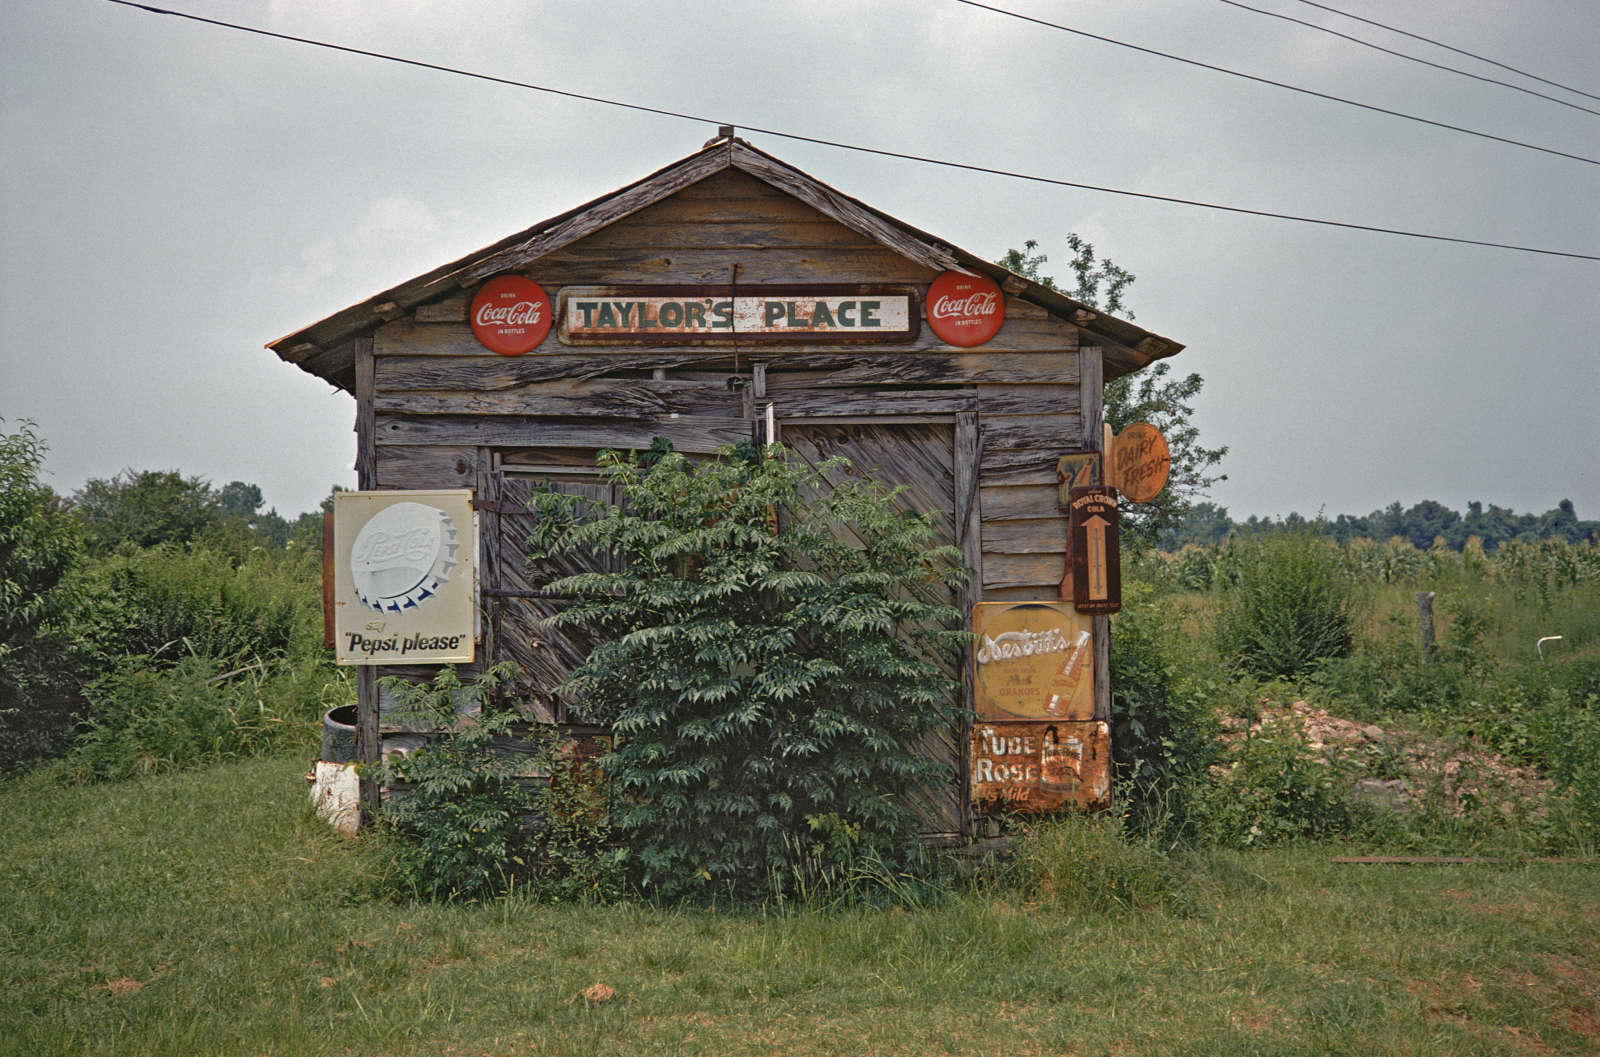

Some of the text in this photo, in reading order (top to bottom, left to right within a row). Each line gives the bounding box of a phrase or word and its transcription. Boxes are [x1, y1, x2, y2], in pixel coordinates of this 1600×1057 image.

[476, 301, 543, 326] Coca-Cola
[576, 298, 881, 329] TAYLOR'S PLACE
[933, 292, 998, 319] Coca-Cola
[1072, 494, 1094, 510] ROYAL
[1087, 505, 1105, 513] COLA
[345, 631, 466, 656] "Pepsi, please"
[999, 687, 1041, 697] ORANGES
[981, 726, 1036, 756] TUBE
[976, 757, 1037, 784] ROSE
